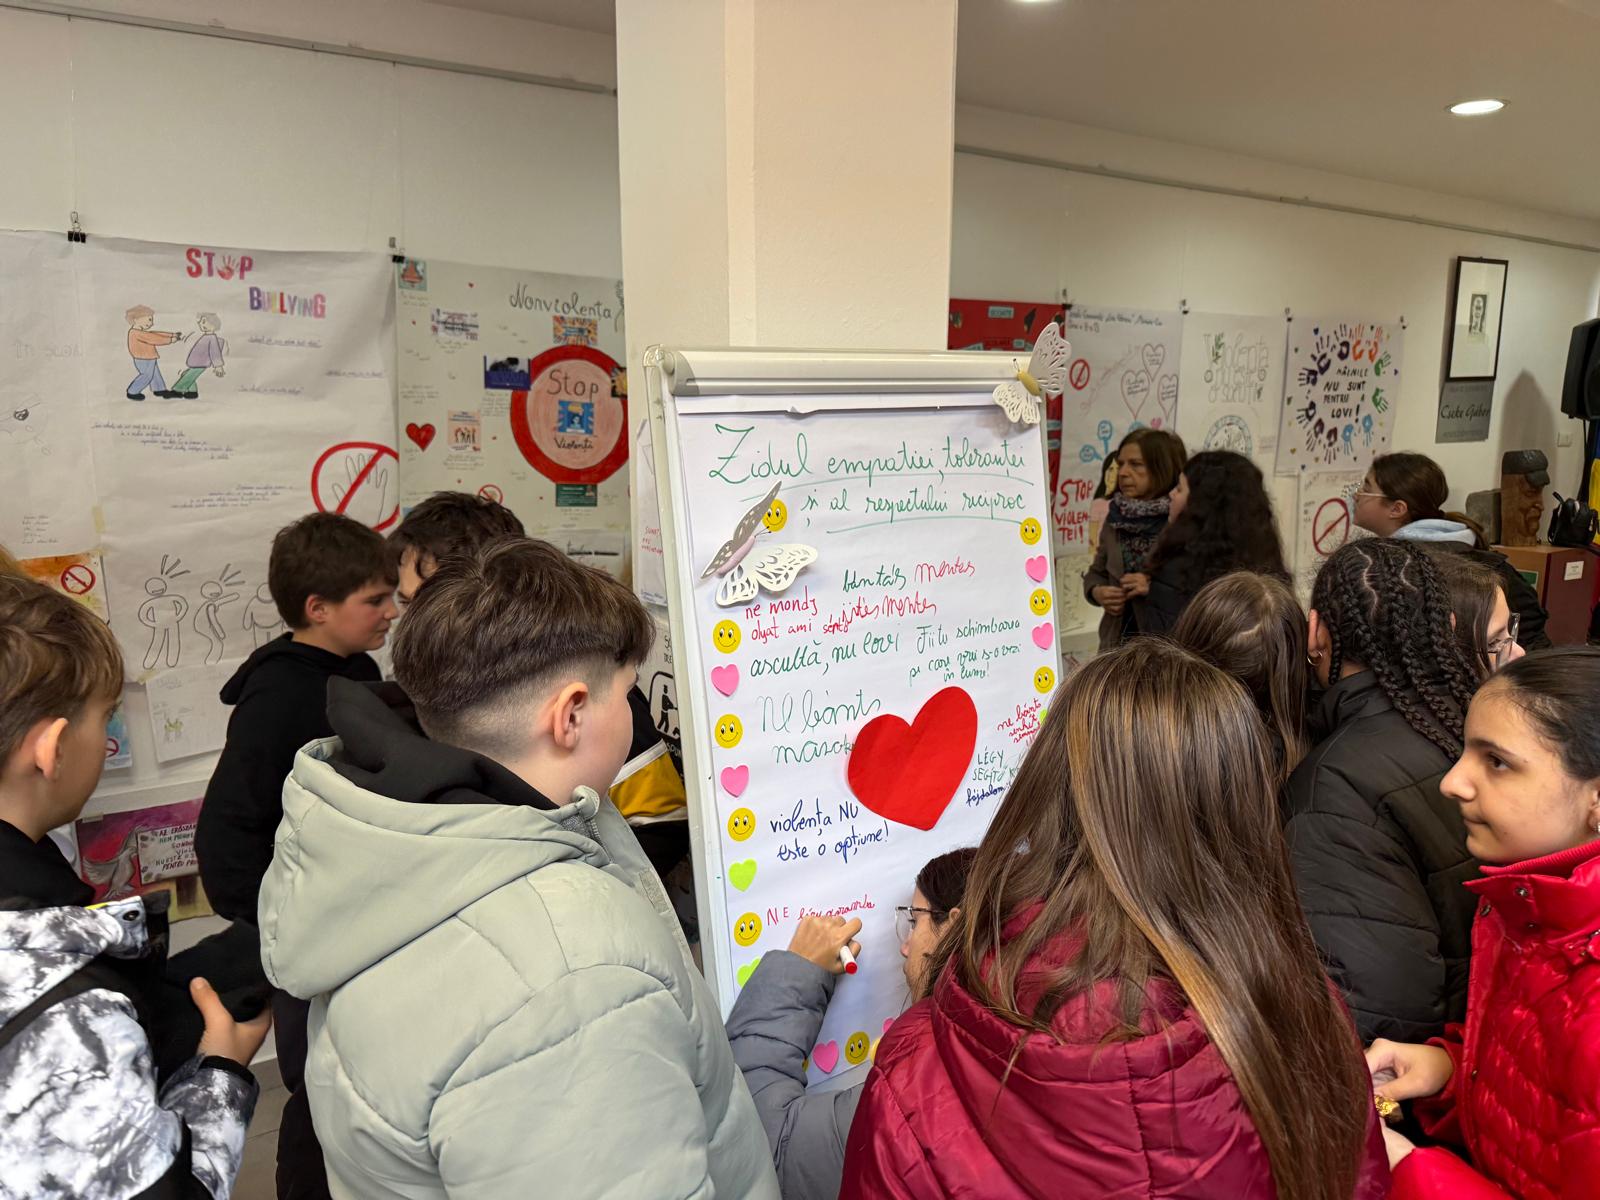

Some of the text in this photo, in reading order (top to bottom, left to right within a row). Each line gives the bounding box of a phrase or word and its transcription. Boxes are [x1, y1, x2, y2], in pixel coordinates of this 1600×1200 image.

[186, 247, 253, 281] STOP
[249, 286, 327, 319] BULLYING
[546, 368, 600, 402] Stop
[1323, 380, 1366, 392] NU SUNT
[1323, 394, 1350, 404] PENTRU
[709, 423, 813, 484] Zidul
[829, 488, 850, 512] al
[865, 484, 948, 524] respectului
[962, 490, 1026, 520] reciproc
[1060, 478, 1094, 508] STOP
[745, 585, 818, 619] ne mondj
[751, 616, 780, 644] olyat
[787, 618, 812, 634] ami
[956, 617, 1020, 639] schimbarea
[831, 642, 857, 664] nu
[977, 745, 1004, 768] LÉGY
[769, 797, 859, 836] violența NU
[777, 837, 810, 861] este
[817, 843, 827, 856] o
[767, 907, 789, 926] NE
